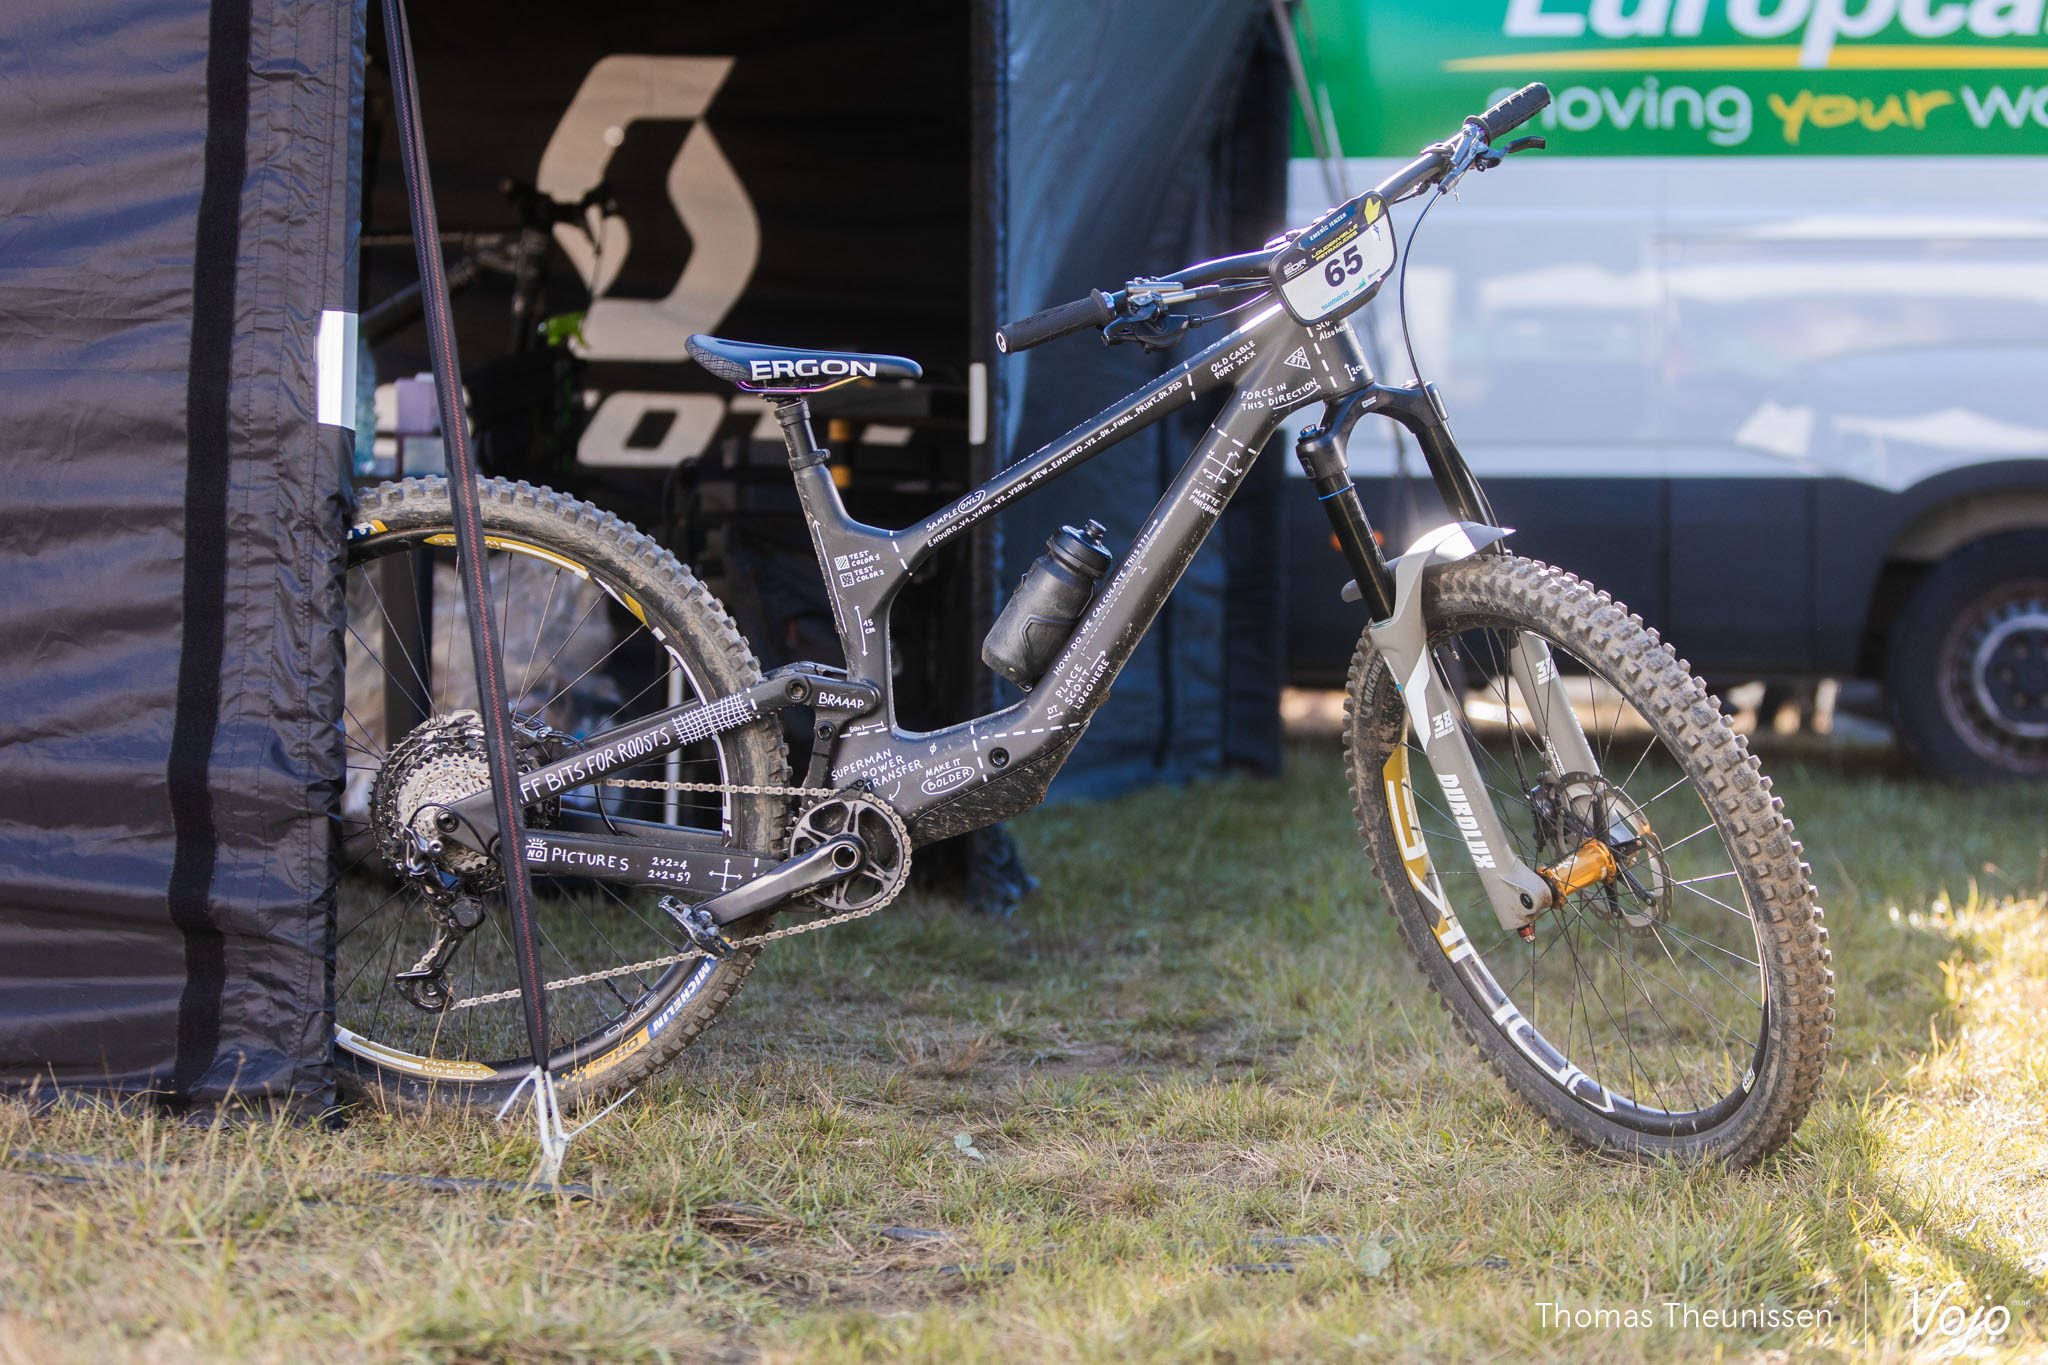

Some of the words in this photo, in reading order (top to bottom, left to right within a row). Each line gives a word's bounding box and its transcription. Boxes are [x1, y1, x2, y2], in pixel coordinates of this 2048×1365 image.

[1767, 89, 1955, 145] your
[1325, 245, 1363, 287] 65
[1321, 290, 1350, 311] SHIMANO
[1211, 354, 1228, 373] OLD
[1230, 340, 1256, 360] CABLE
[750, 359, 877, 381] ERGON
[1214, 365, 1237, 379] PORT
[1241, 385, 1273, 400] FORCE
[1277, 383, 1287, 392] IN
[1241, 401, 1264, 411] THIS
[1268, 378, 1318, 406] DIRECTION
[1189, 495, 1221, 516] FINISHING
[1192, 488, 1220, 507] MATTE
[926, 509, 958, 532] SAMPLE
[960, 492, 982, 511] ONLY
[848, 550, 869, 560] TEST
[854, 566, 874, 576] TEST
[863, 618, 873, 627] 15
[1053, 651, 1071, 677] HOW
[1070, 636, 1082, 650] DO
[1081, 619, 1093, 634] WE
[1092, 571, 1127, 618] CALCULATE
[1055, 663, 1083, 698] PLACE
[1064, 669, 1091, 706] SCOTT
[1074, 684, 1094, 710] LOGO
[1091, 658, 1110, 685] HERE
[1363, 653, 1386, 704] MICHEL
[818, 692, 865, 709] BRAAAP
[1432, 709, 1453, 732] 38
[519, 778, 542, 805] FF
[545, 762, 586, 792] BITS
[586, 752, 620, 773] FOR
[617, 726, 671, 761] ROOSTS
[831, 748, 892, 781] SUPERMAN
[862, 755, 905, 778] POWER
[864, 759, 923, 791] TRANSFER
[925, 763, 952, 778] MAKE
[952, 758, 961, 767] IT
[927, 769, 971, 791] BOLDER
[1437, 773, 1497, 870] DUROLUX
[526, 849, 543, 859] NO
[551, 848, 629, 871] PICTURES
[651, 856, 688, 870] 2+2=4
[647, 869, 692, 884] 2+2=5?
[652, 960, 711, 1032] MICHELIN
[424, 1059, 480, 1069] RACING
[424, 1066, 488, 1077] WHEELS
